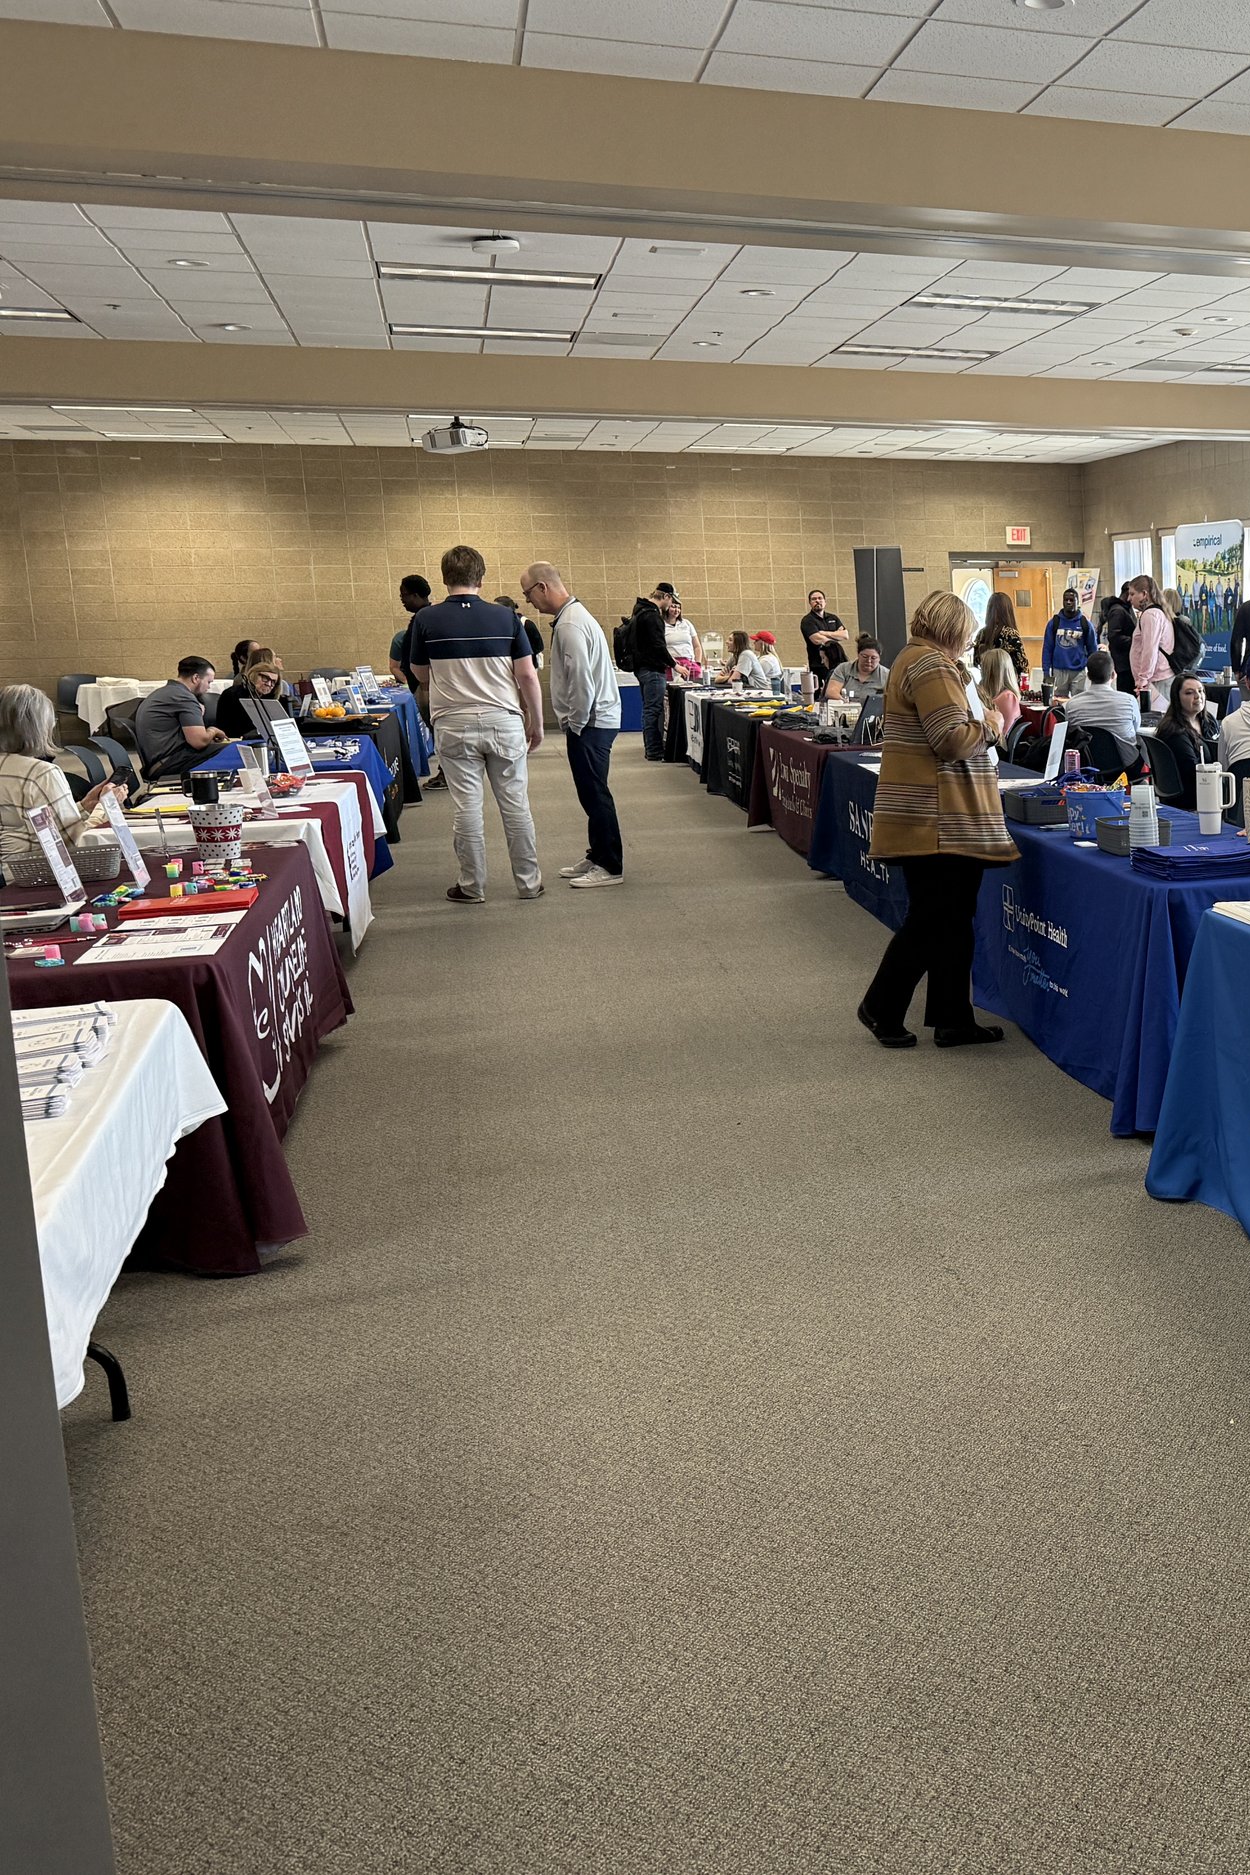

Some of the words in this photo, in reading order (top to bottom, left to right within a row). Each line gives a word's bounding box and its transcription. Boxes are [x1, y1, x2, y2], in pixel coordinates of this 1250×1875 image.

[1011, 528, 1027, 542] EXIT
[1195, 534, 1223, 549] empirical
[849, 800, 873, 843] SANF
[1047, 920, 1068, 949] Health
